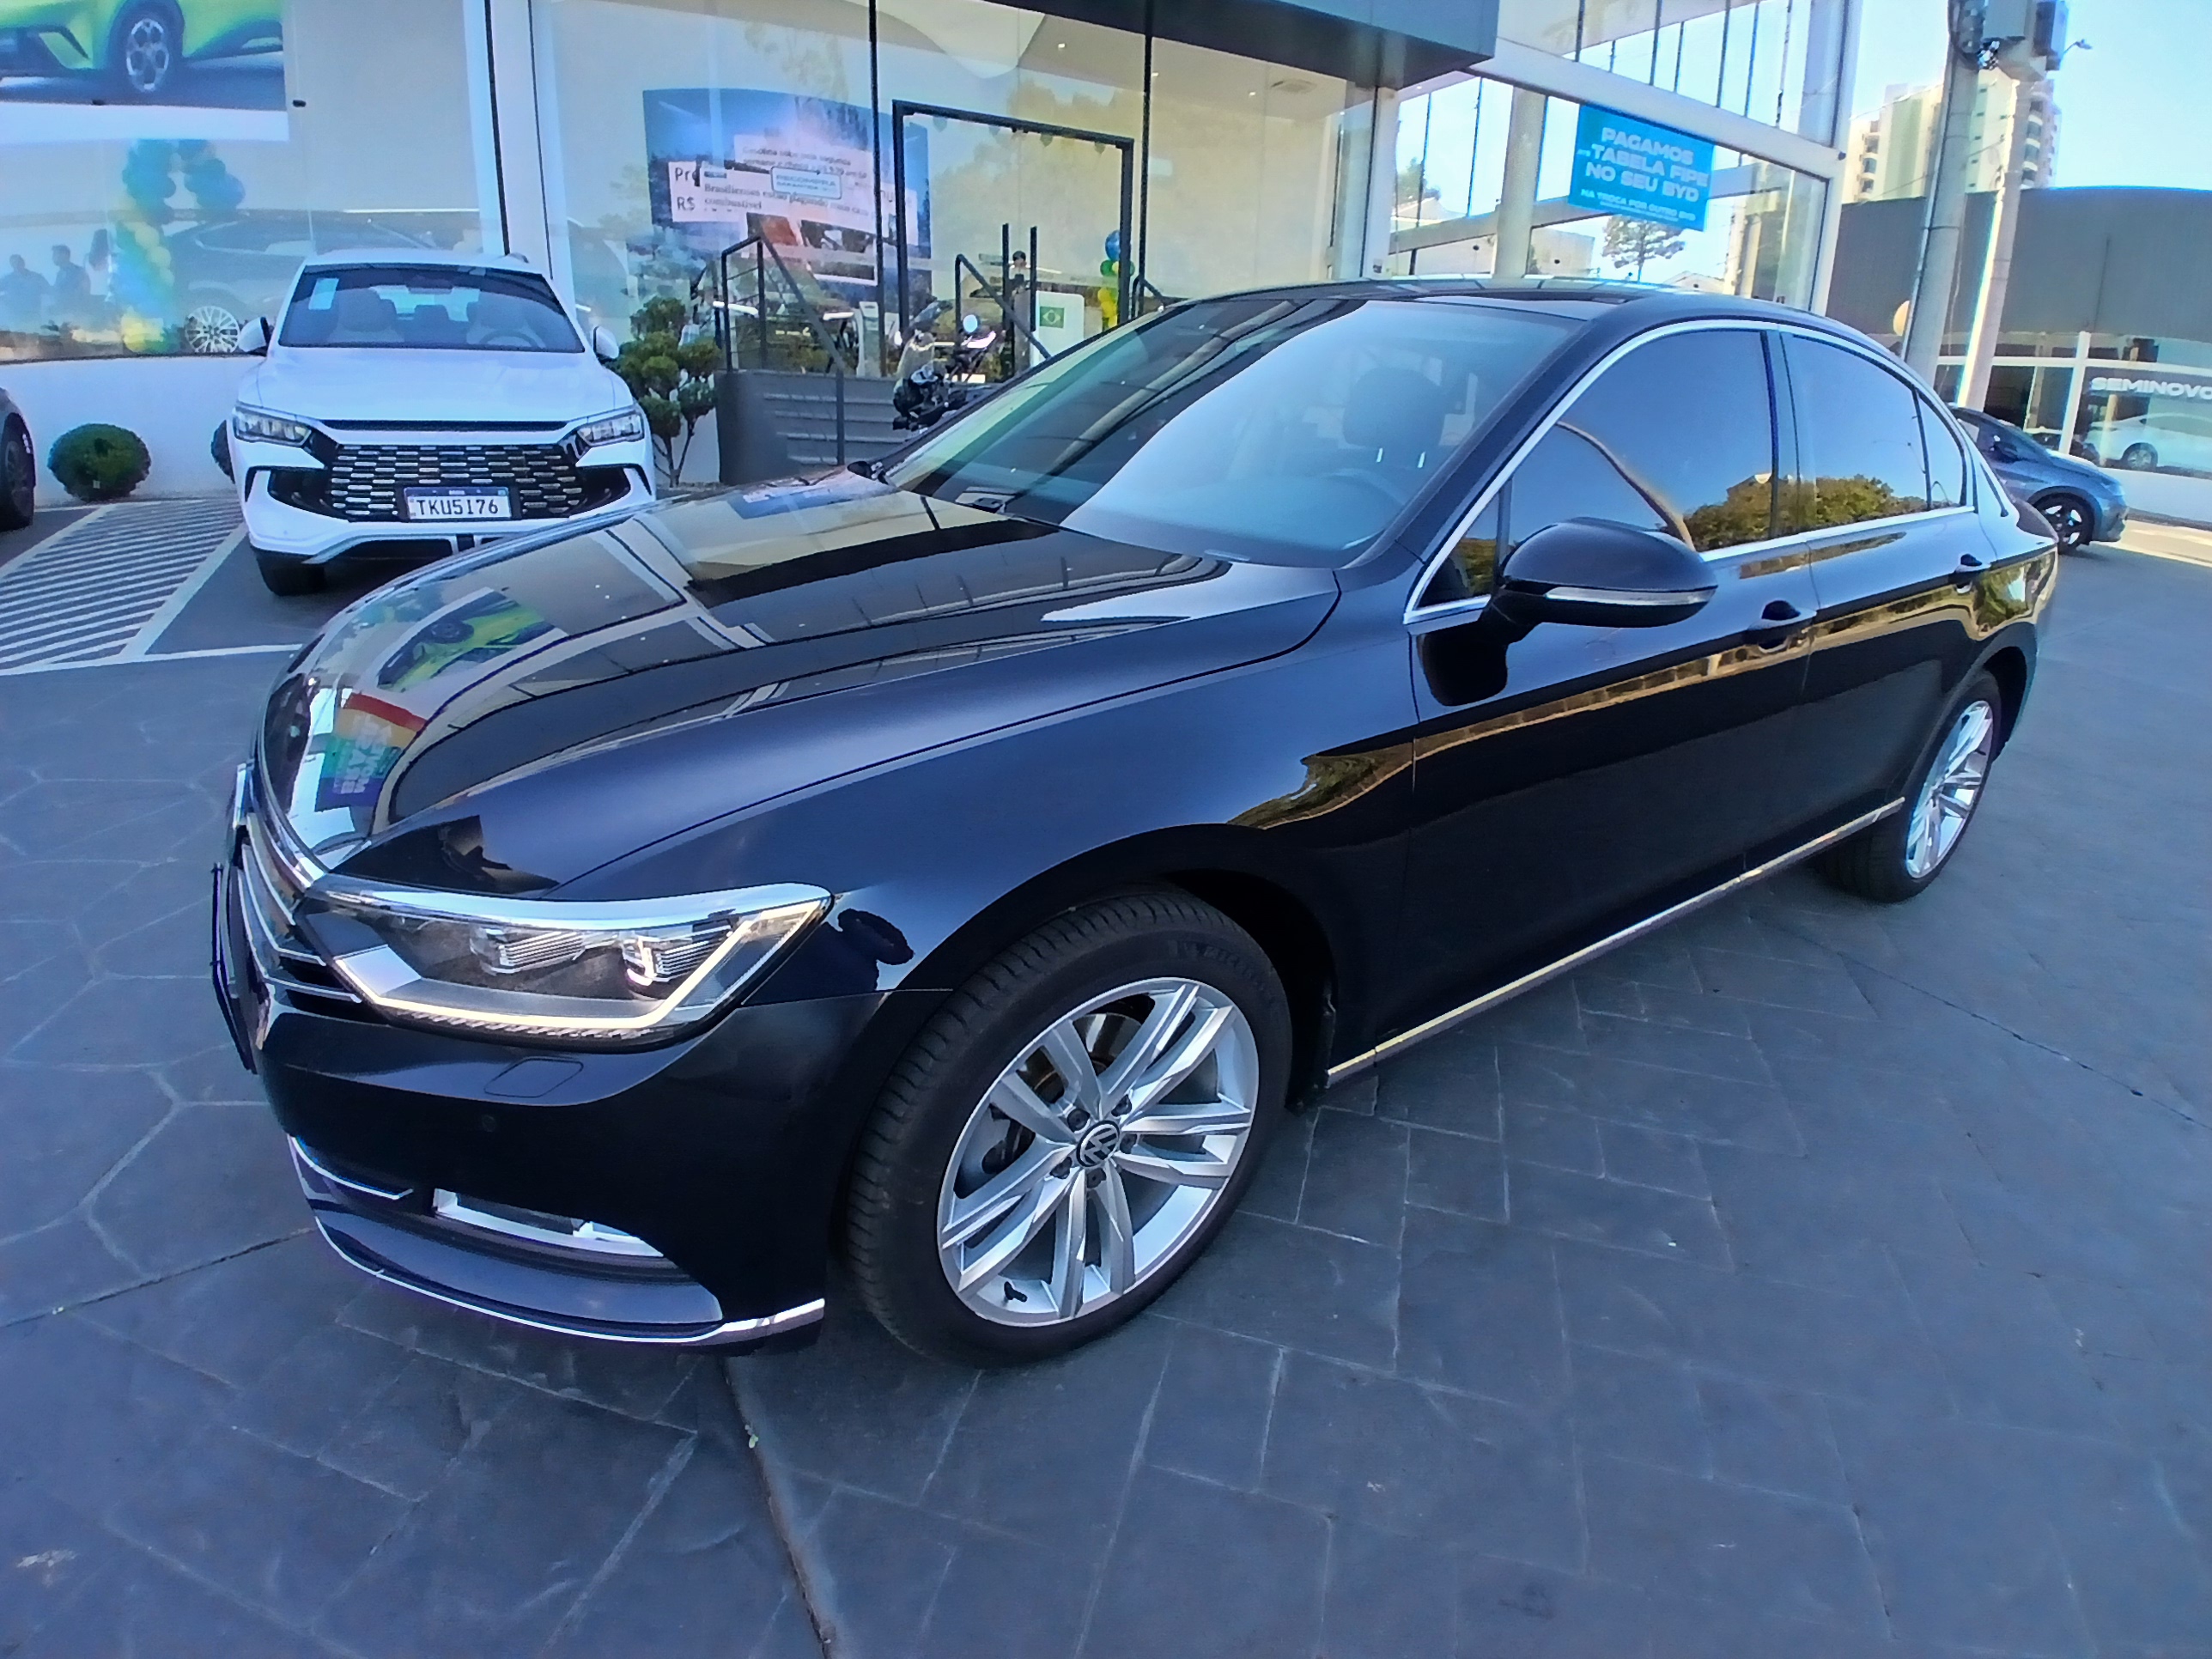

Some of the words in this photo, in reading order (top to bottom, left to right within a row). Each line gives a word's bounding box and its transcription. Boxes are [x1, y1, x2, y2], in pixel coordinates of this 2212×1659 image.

[1601, 127, 1694, 165] PAGAMOS
[1591, 143, 1665, 176] TABELA
[1670, 165, 1709, 187] FIPE
[1585, 161, 1616, 182] NO
[1620, 170, 1658, 192] SEU
[1662, 180, 1699, 203] BYD
[677, 196, 696, 211] R$
[1597, 192, 1626, 205] TROCA
[1629, 199, 1647, 210] POR
[1649, 204, 1677, 216] OUTRO
[2091, 377, 2212, 400] SEMINOVO
